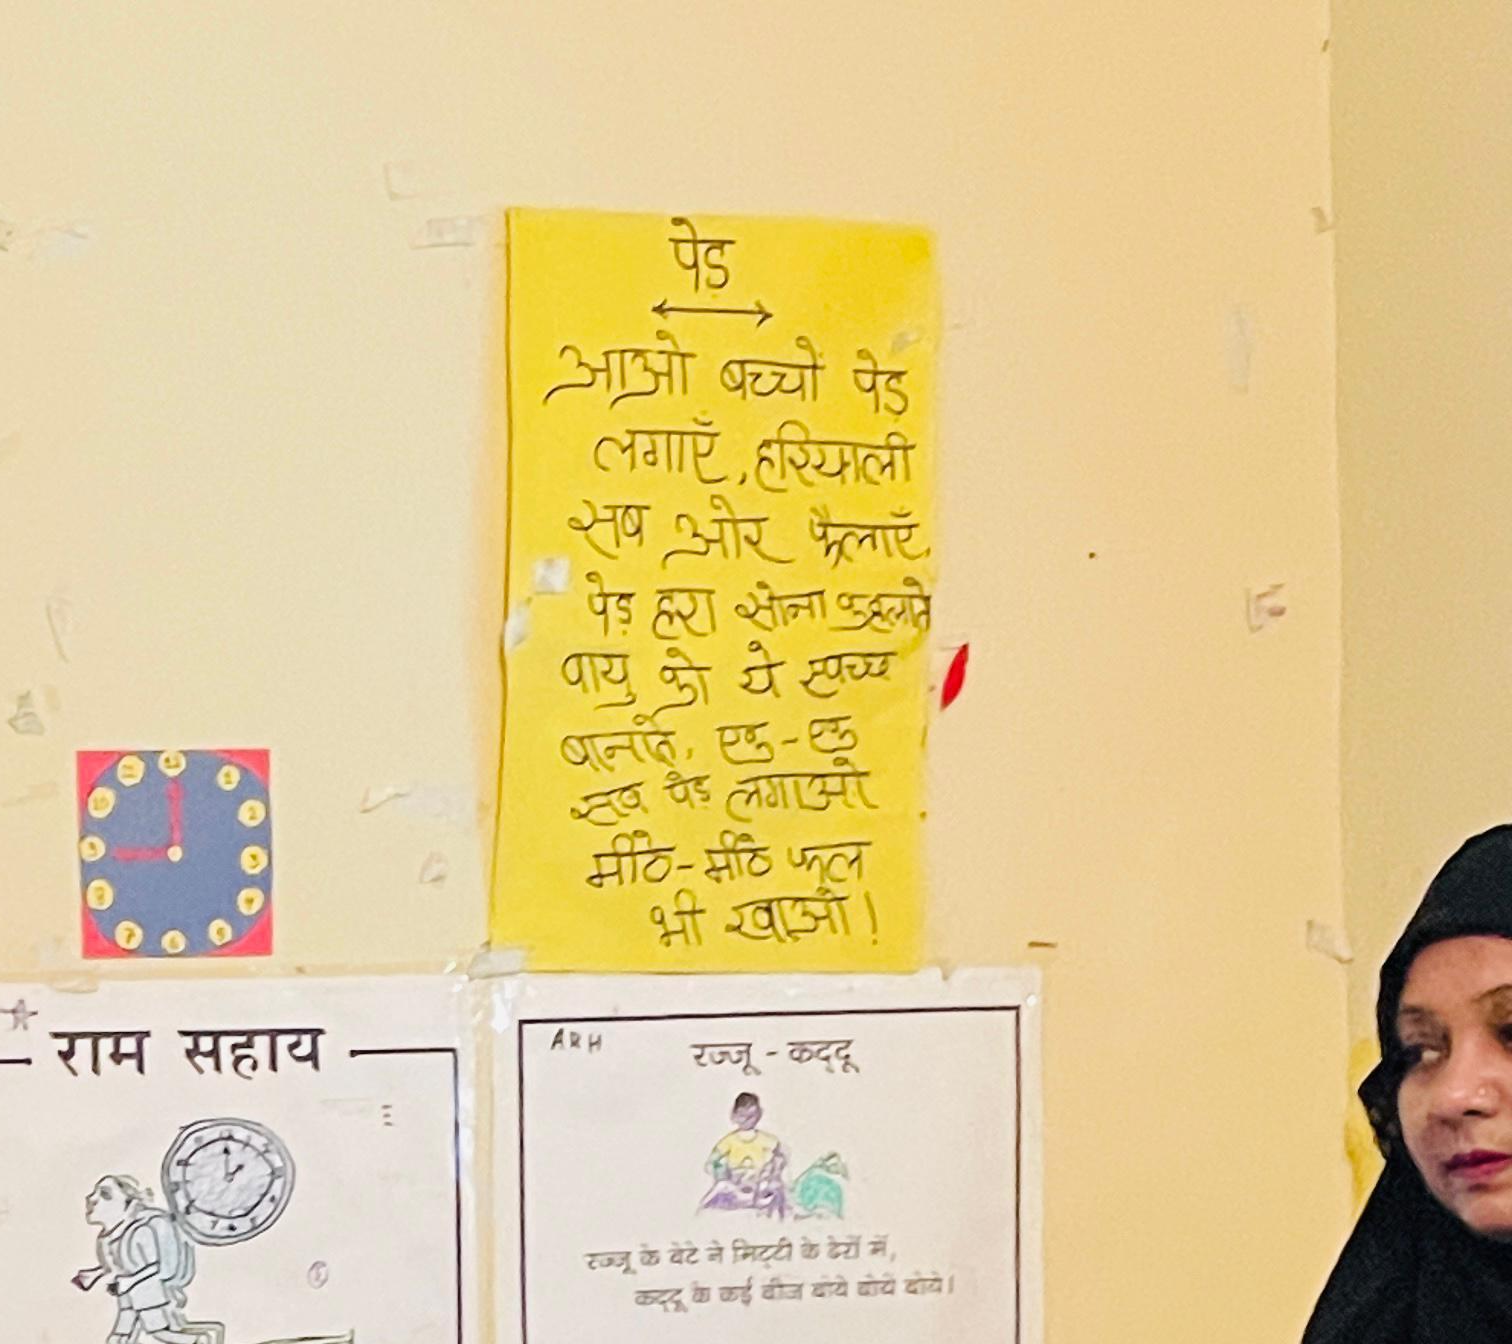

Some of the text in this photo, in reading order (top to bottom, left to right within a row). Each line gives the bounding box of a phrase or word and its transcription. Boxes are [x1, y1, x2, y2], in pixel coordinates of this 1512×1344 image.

[668, 217, 736, 297] पेड़
[543, 329, 697, 408] आओ
[852, 347, 909, 422] पेड़
[754, 420, 916, 493] हरियाली
[568, 499, 650, 560] सब
[662, 494, 796, 569] ओर
[586, 571, 636, 637] पेड़
[651, 588, 716, 640] हरा
[735, 581, 828, 632] सोना
[562, 652, 637, 710] वायु
[653, 647, 711, 713] को
[740, 641, 787, 698] ये
[726, 757, 879, 823] लगाओ
[650, 888, 706, 946] भी
[50, 1028, 326, 1079] राम सहाय
[690, 1042, 763, 1076] रज्जू
